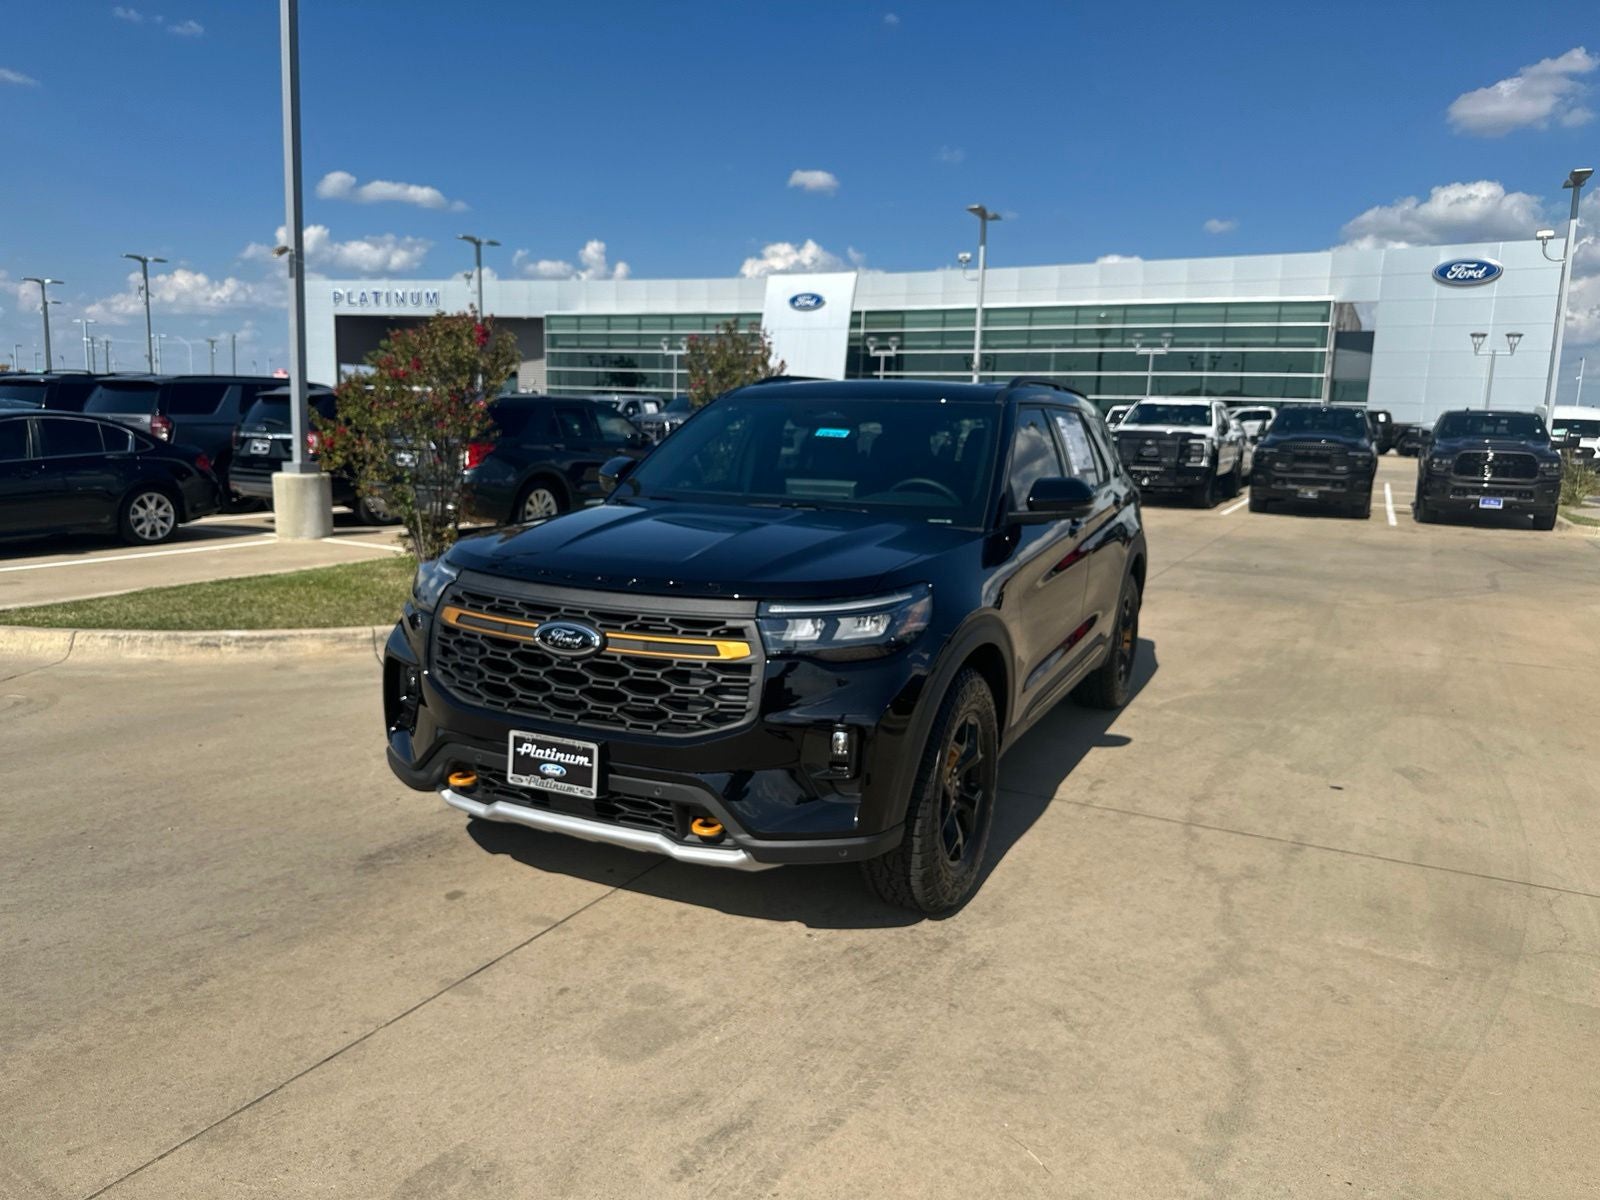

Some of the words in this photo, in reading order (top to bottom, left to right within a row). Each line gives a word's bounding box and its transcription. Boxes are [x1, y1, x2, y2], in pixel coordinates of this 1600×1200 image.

[1447, 263, 1487, 279] Ford
[332, 290, 440, 306] PLATINUM
[547, 628, 583, 648] Ford
[516, 743, 592, 766] Platinum
